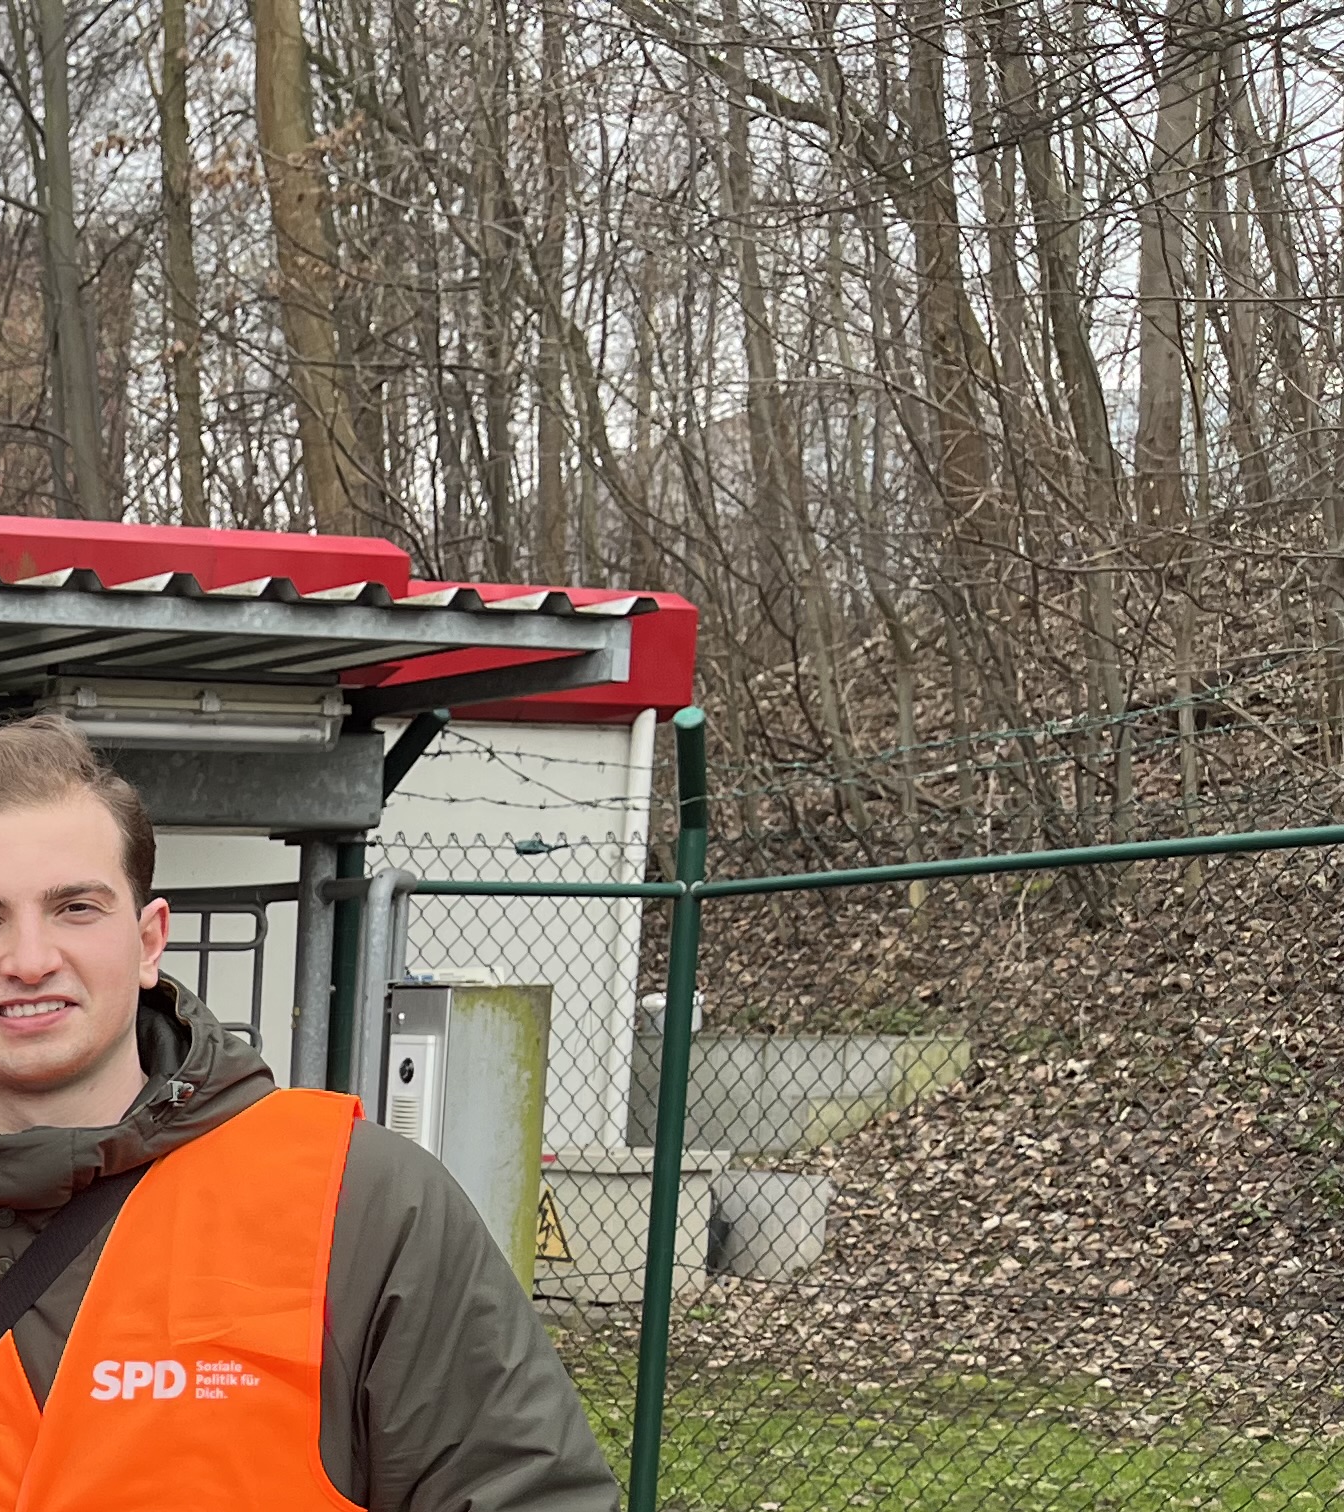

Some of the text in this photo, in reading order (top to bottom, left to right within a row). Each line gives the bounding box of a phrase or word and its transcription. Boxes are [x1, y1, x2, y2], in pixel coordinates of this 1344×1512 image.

[90, 1359, 243, 1400] SPD Soziale
[195, 1374, 260, 1386] Politik für
[195, 1387, 229, 1400] Dich.
